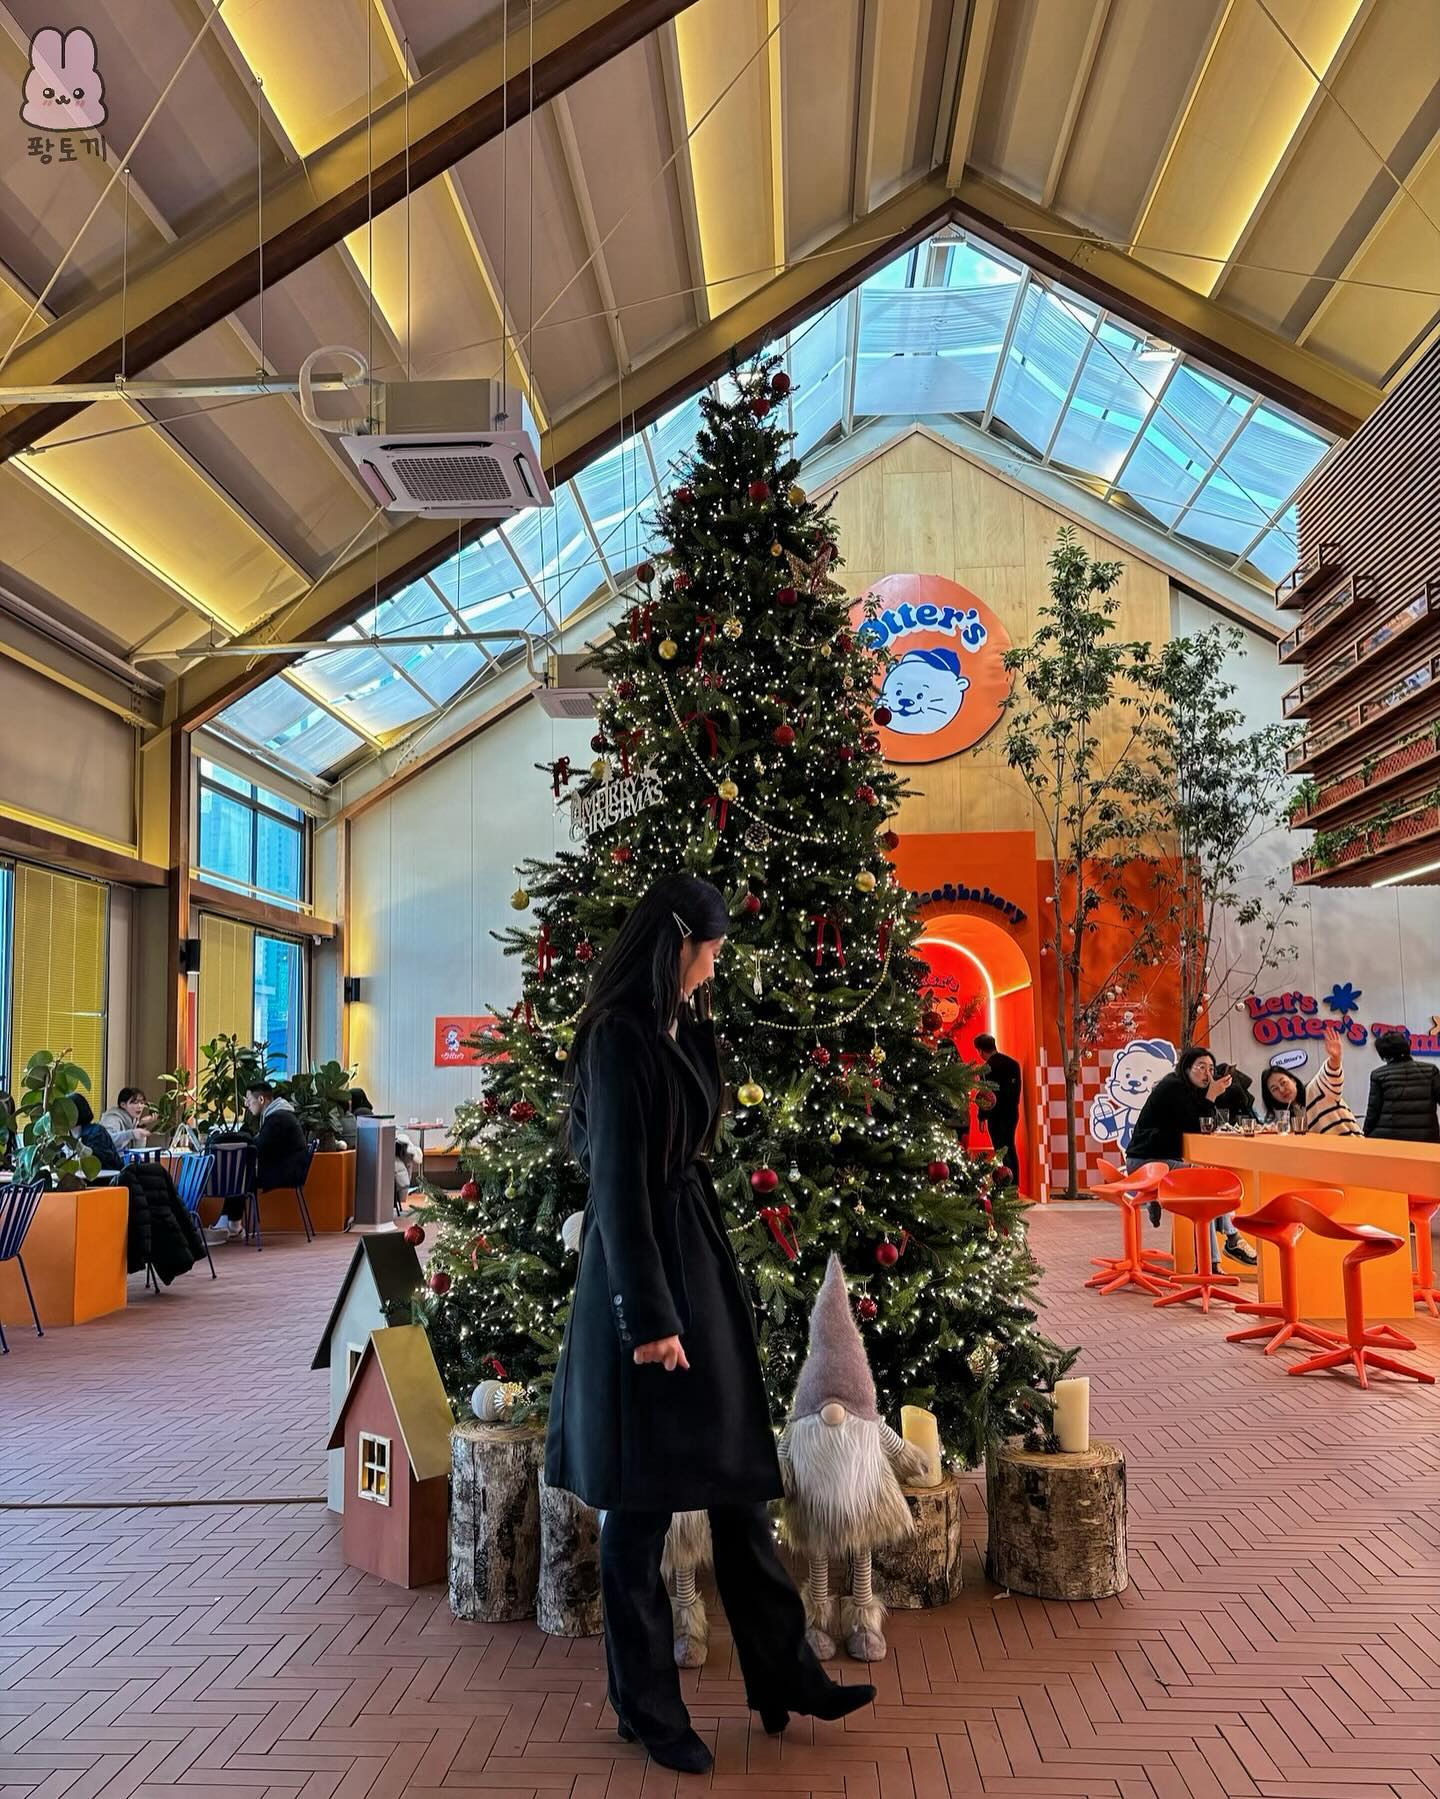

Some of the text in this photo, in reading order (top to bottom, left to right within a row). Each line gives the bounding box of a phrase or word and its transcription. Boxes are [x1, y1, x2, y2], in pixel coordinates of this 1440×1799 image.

[857, 602, 988, 651] Otter's
[569, 782, 663, 843] CHRISTMAS
[581, 776, 639, 820] MERRY
[1244, 991, 1318, 1019] Let's
[1253, 1014, 1367, 1046] Otter's
